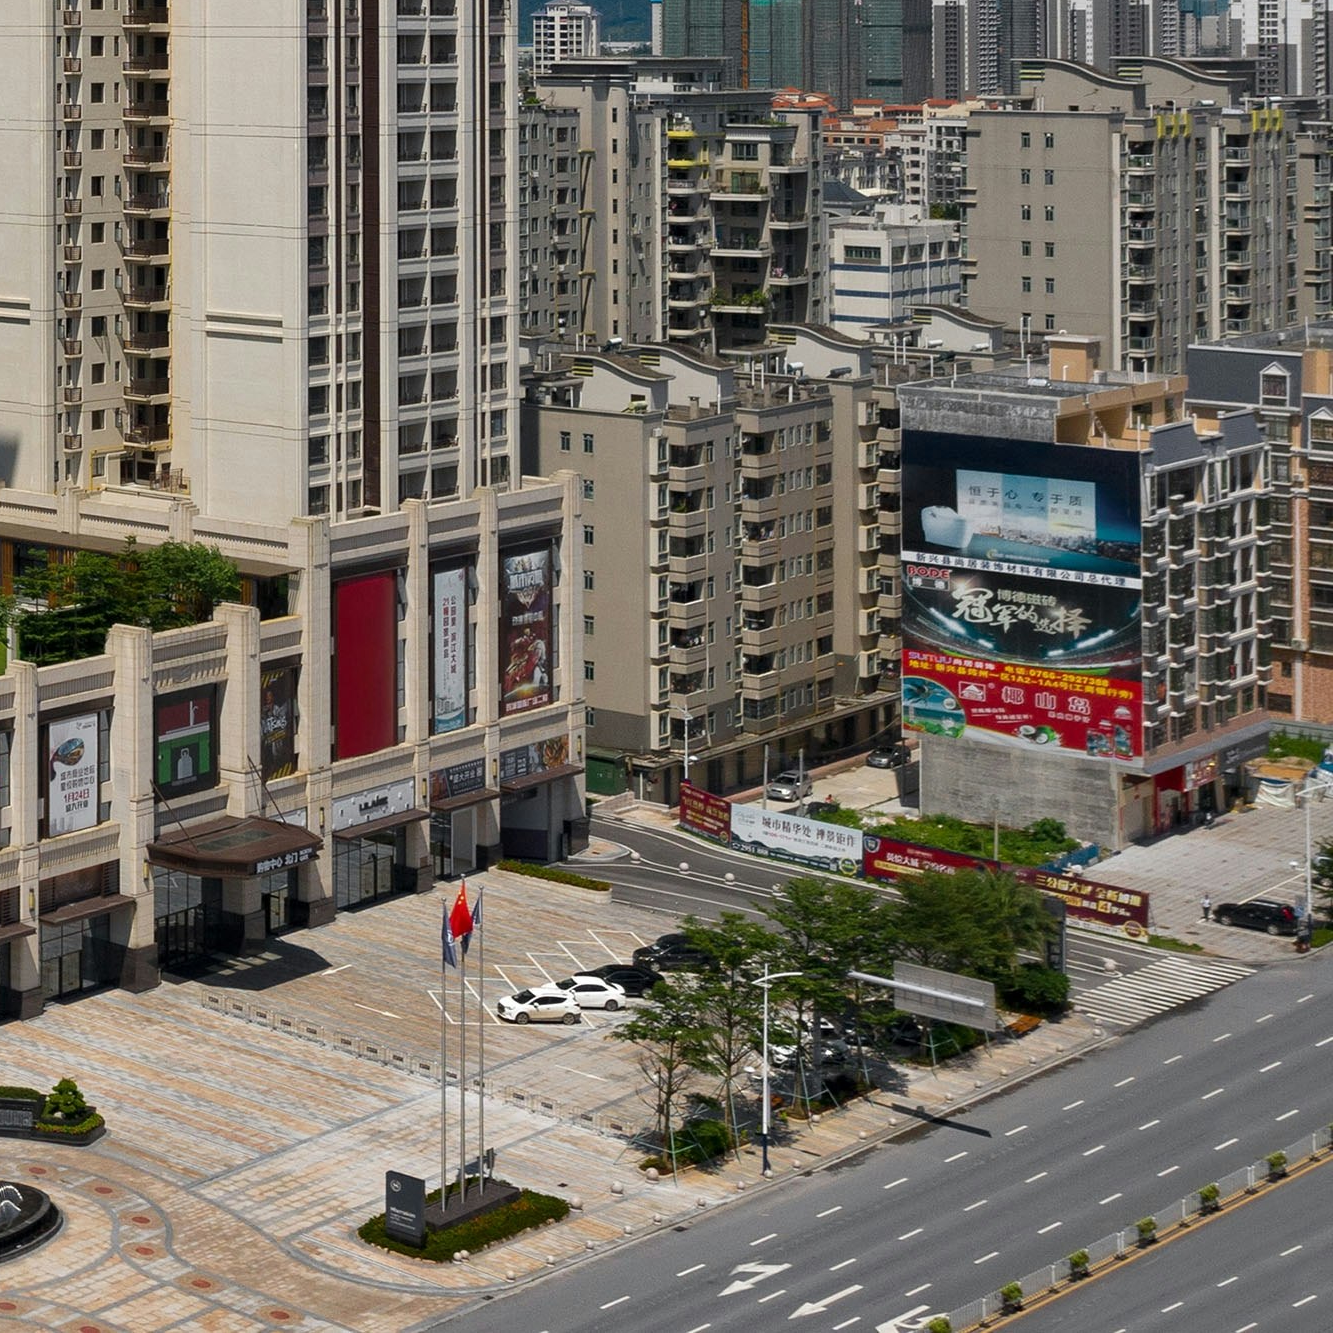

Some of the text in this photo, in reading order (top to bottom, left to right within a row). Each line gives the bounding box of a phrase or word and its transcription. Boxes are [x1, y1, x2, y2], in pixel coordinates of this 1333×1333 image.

[907, 565, 950, 579] BODE
[997, 588, 1057, 606] 博德磁砖
[951, 587, 1092, 639] 冠军的选择
[64, 788, 90, 804] 1月24日
[762, 816, 812, 838] 城市精华处
[257, 856, 282, 874] 购物中心
[285, 851, 299, 865] 北门
